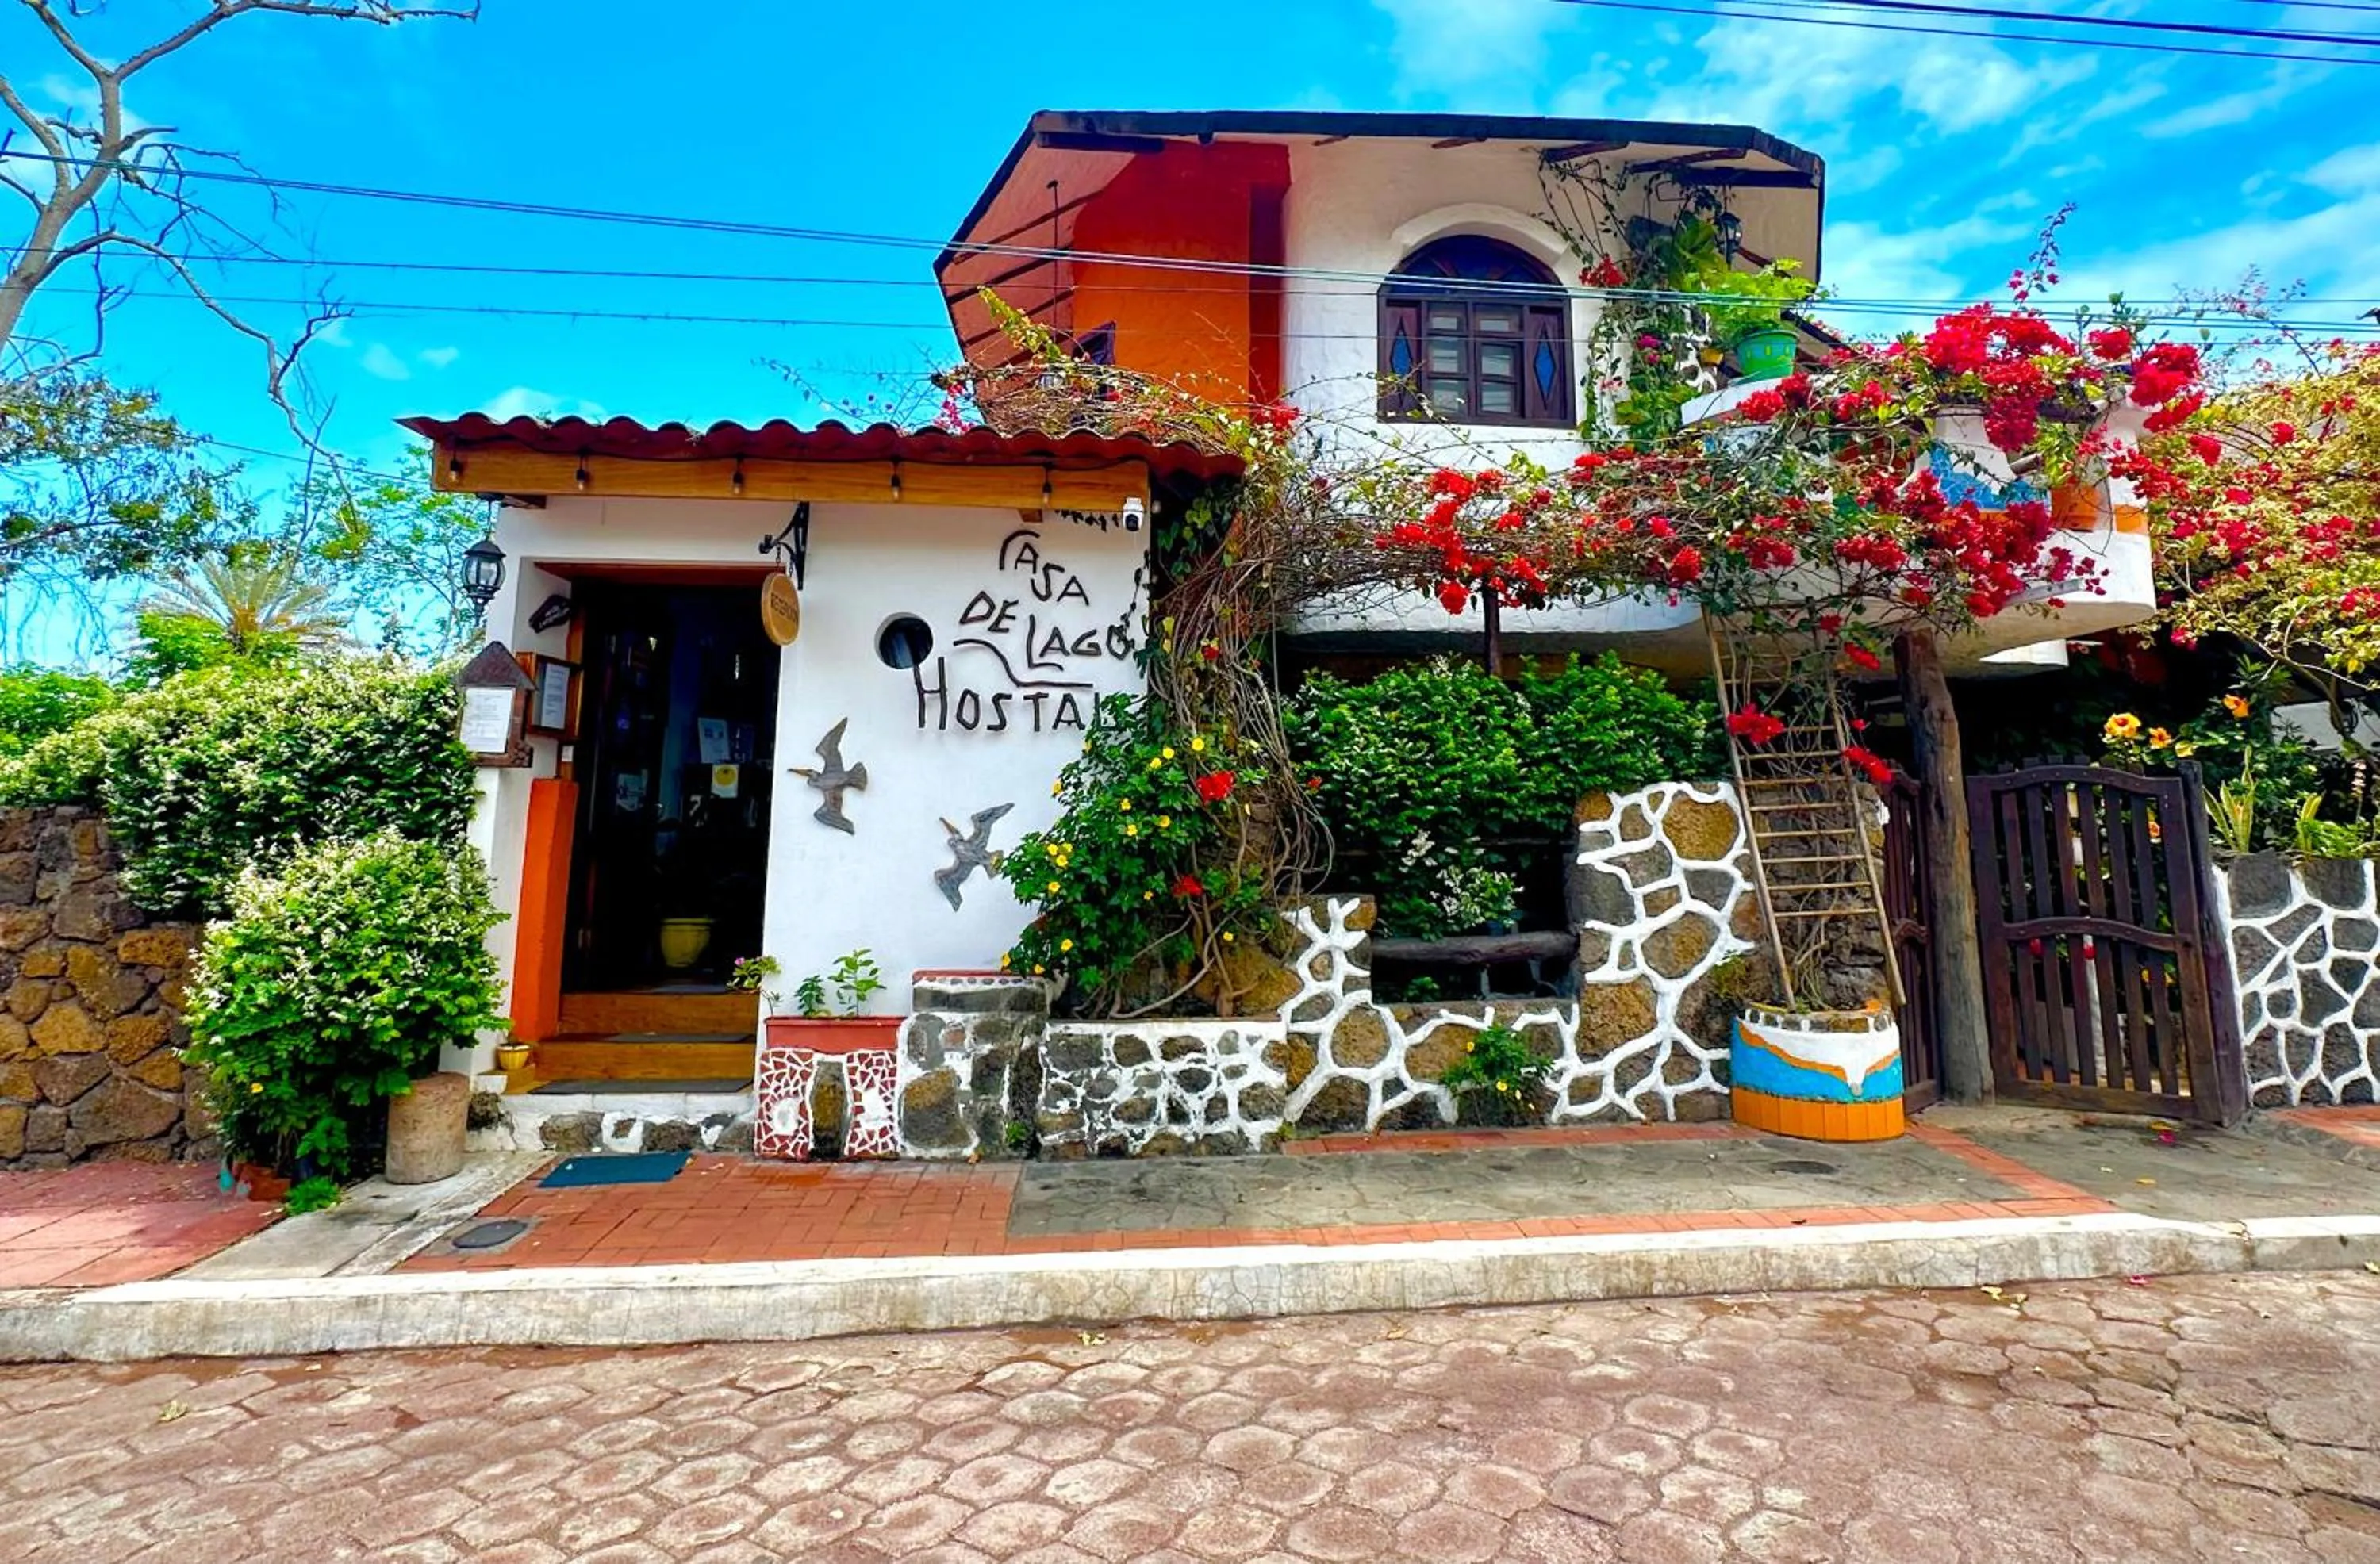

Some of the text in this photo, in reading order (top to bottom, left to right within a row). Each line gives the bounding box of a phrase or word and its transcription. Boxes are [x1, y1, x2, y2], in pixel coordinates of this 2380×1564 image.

[999, 530, 1089, 606] CASA
[958, 590, 1133, 672] DE LAGO
[913, 656, 1124, 732] HOSTAL
